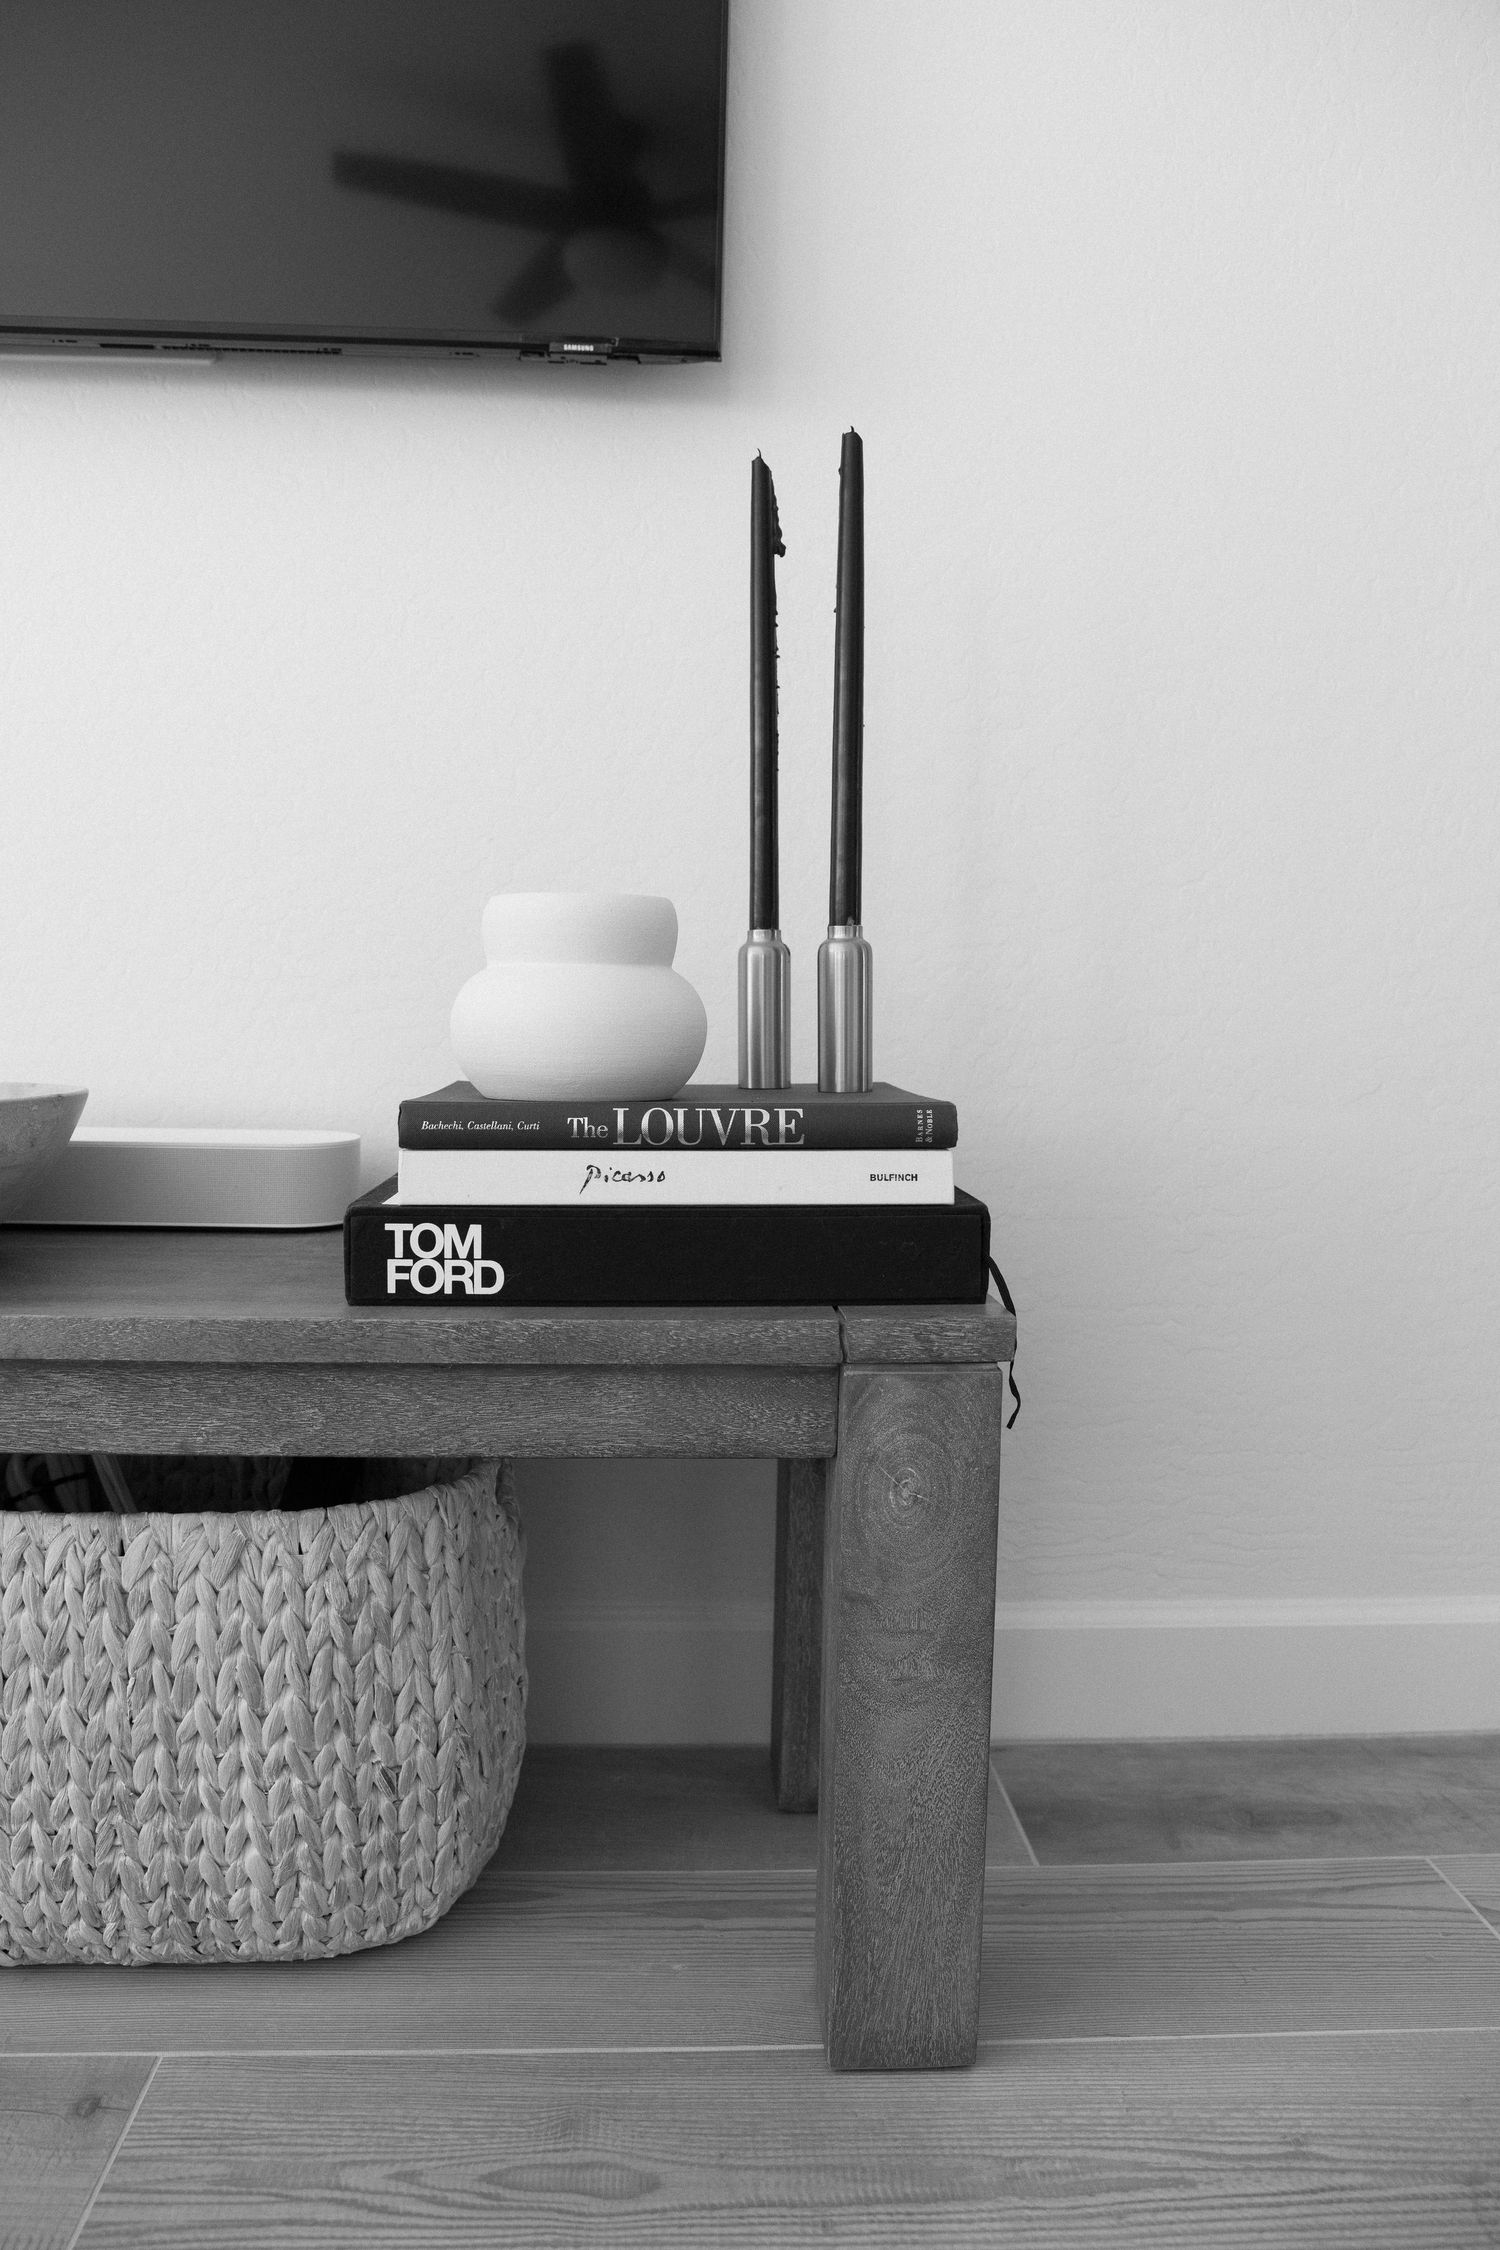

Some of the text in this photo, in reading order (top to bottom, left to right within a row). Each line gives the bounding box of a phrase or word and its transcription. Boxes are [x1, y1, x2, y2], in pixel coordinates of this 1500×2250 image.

[564, 344, 594, 352] SAMSUNG
[421, 1120, 540, 1131] Bachechi, Castellani, Curti
[567, 1107, 805, 1146] The LOUVRE
[915, 1109, 924, 1143] BARNES
[925, 1109, 934, 1135] NOBLE
[579, 1164, 666, 1195] Picasso
[870, 1173, 918, 1182] BULFINCH
[384, 1222, 482, 1259] TOM
[387, 1258, 505, 1295] FORD
